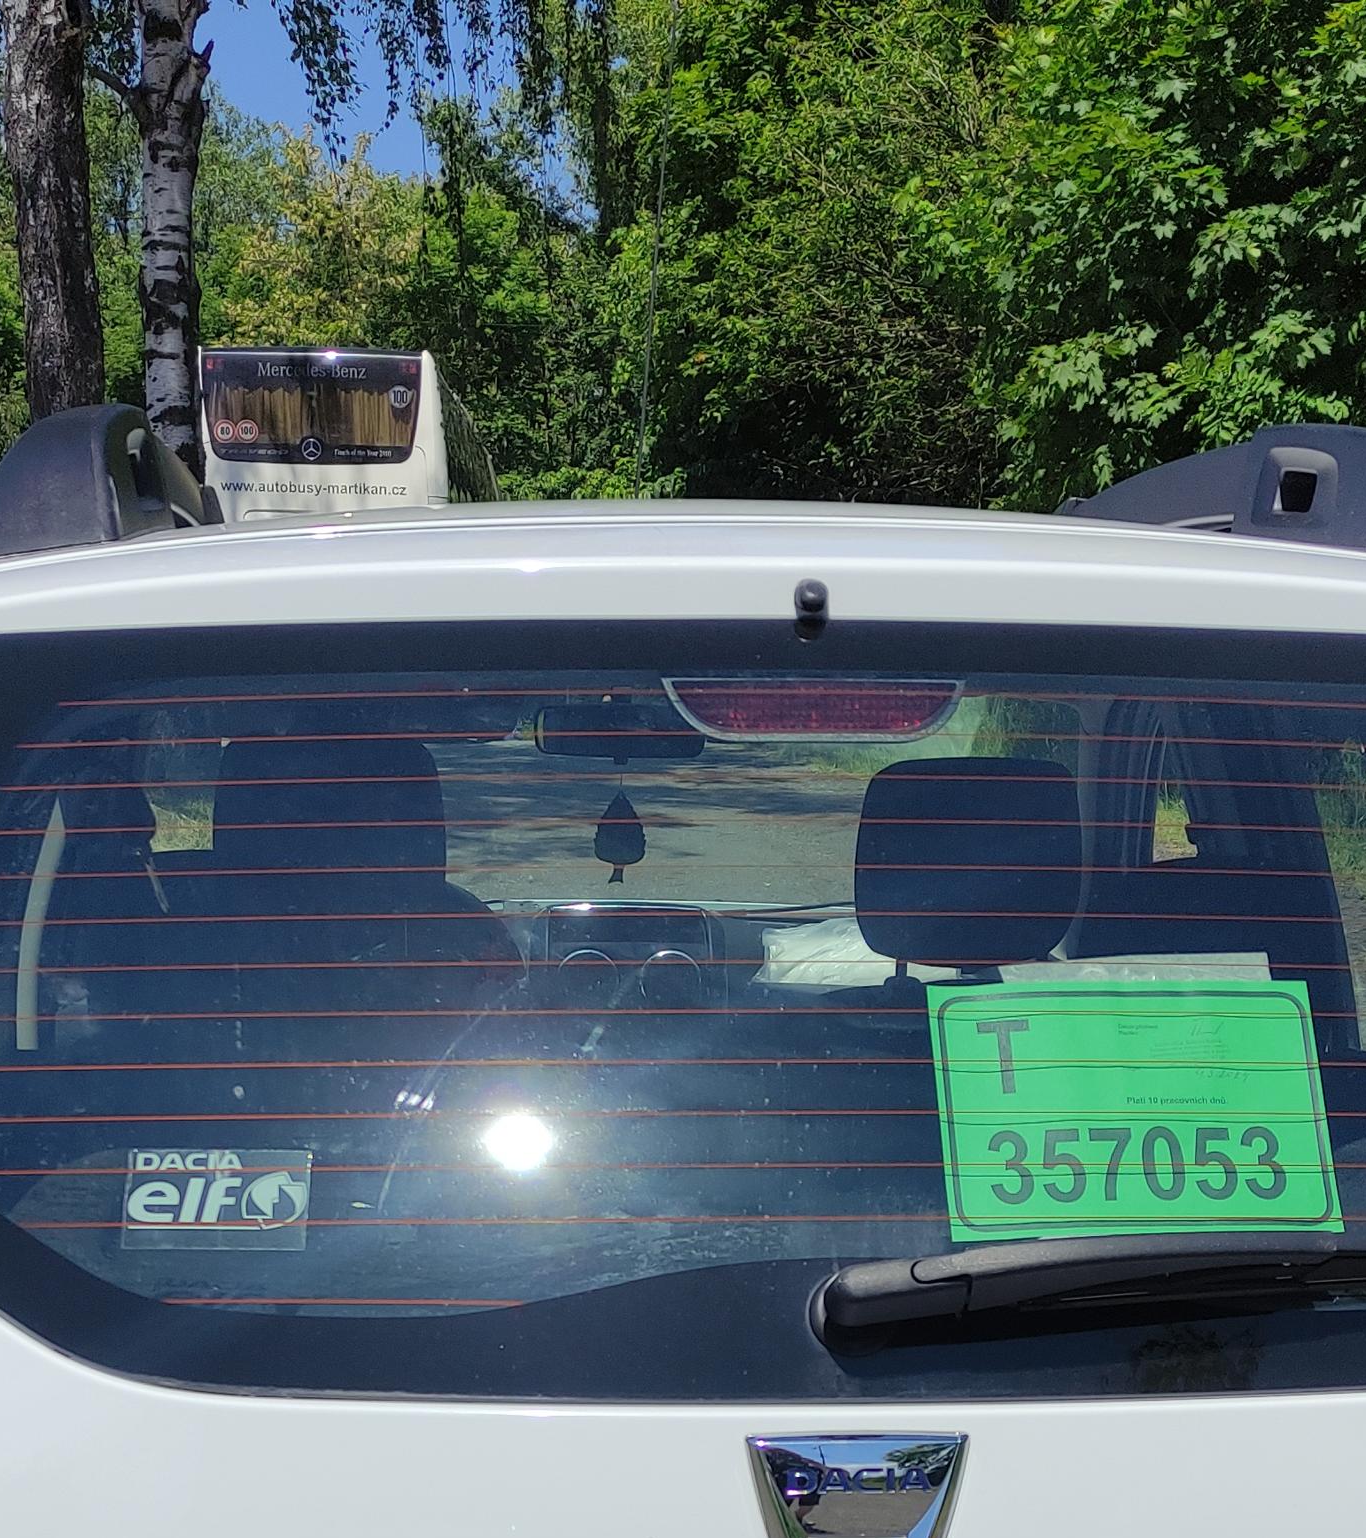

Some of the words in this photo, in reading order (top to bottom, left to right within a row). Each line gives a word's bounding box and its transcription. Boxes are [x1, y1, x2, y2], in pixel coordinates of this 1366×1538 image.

[257, 361, 367, 380] Mercees-Benz
[392, 389, 408, 404] 100
[220, 426, 231, 436] 80
[239, 425, 254, 436] 100
[220, 480, 408, 497] www.autobusy-martikan.cz
[976, 1019, 1029, 1094] T
[1148, 1096, 1158, 1105] 10
[136, 1152, 244, 1171] DACIA
[987, 1125, 1288, 1205] 357053
[127, 1176, 244, 1224] elf
[785, 1467, 932, 1495] DACIA
